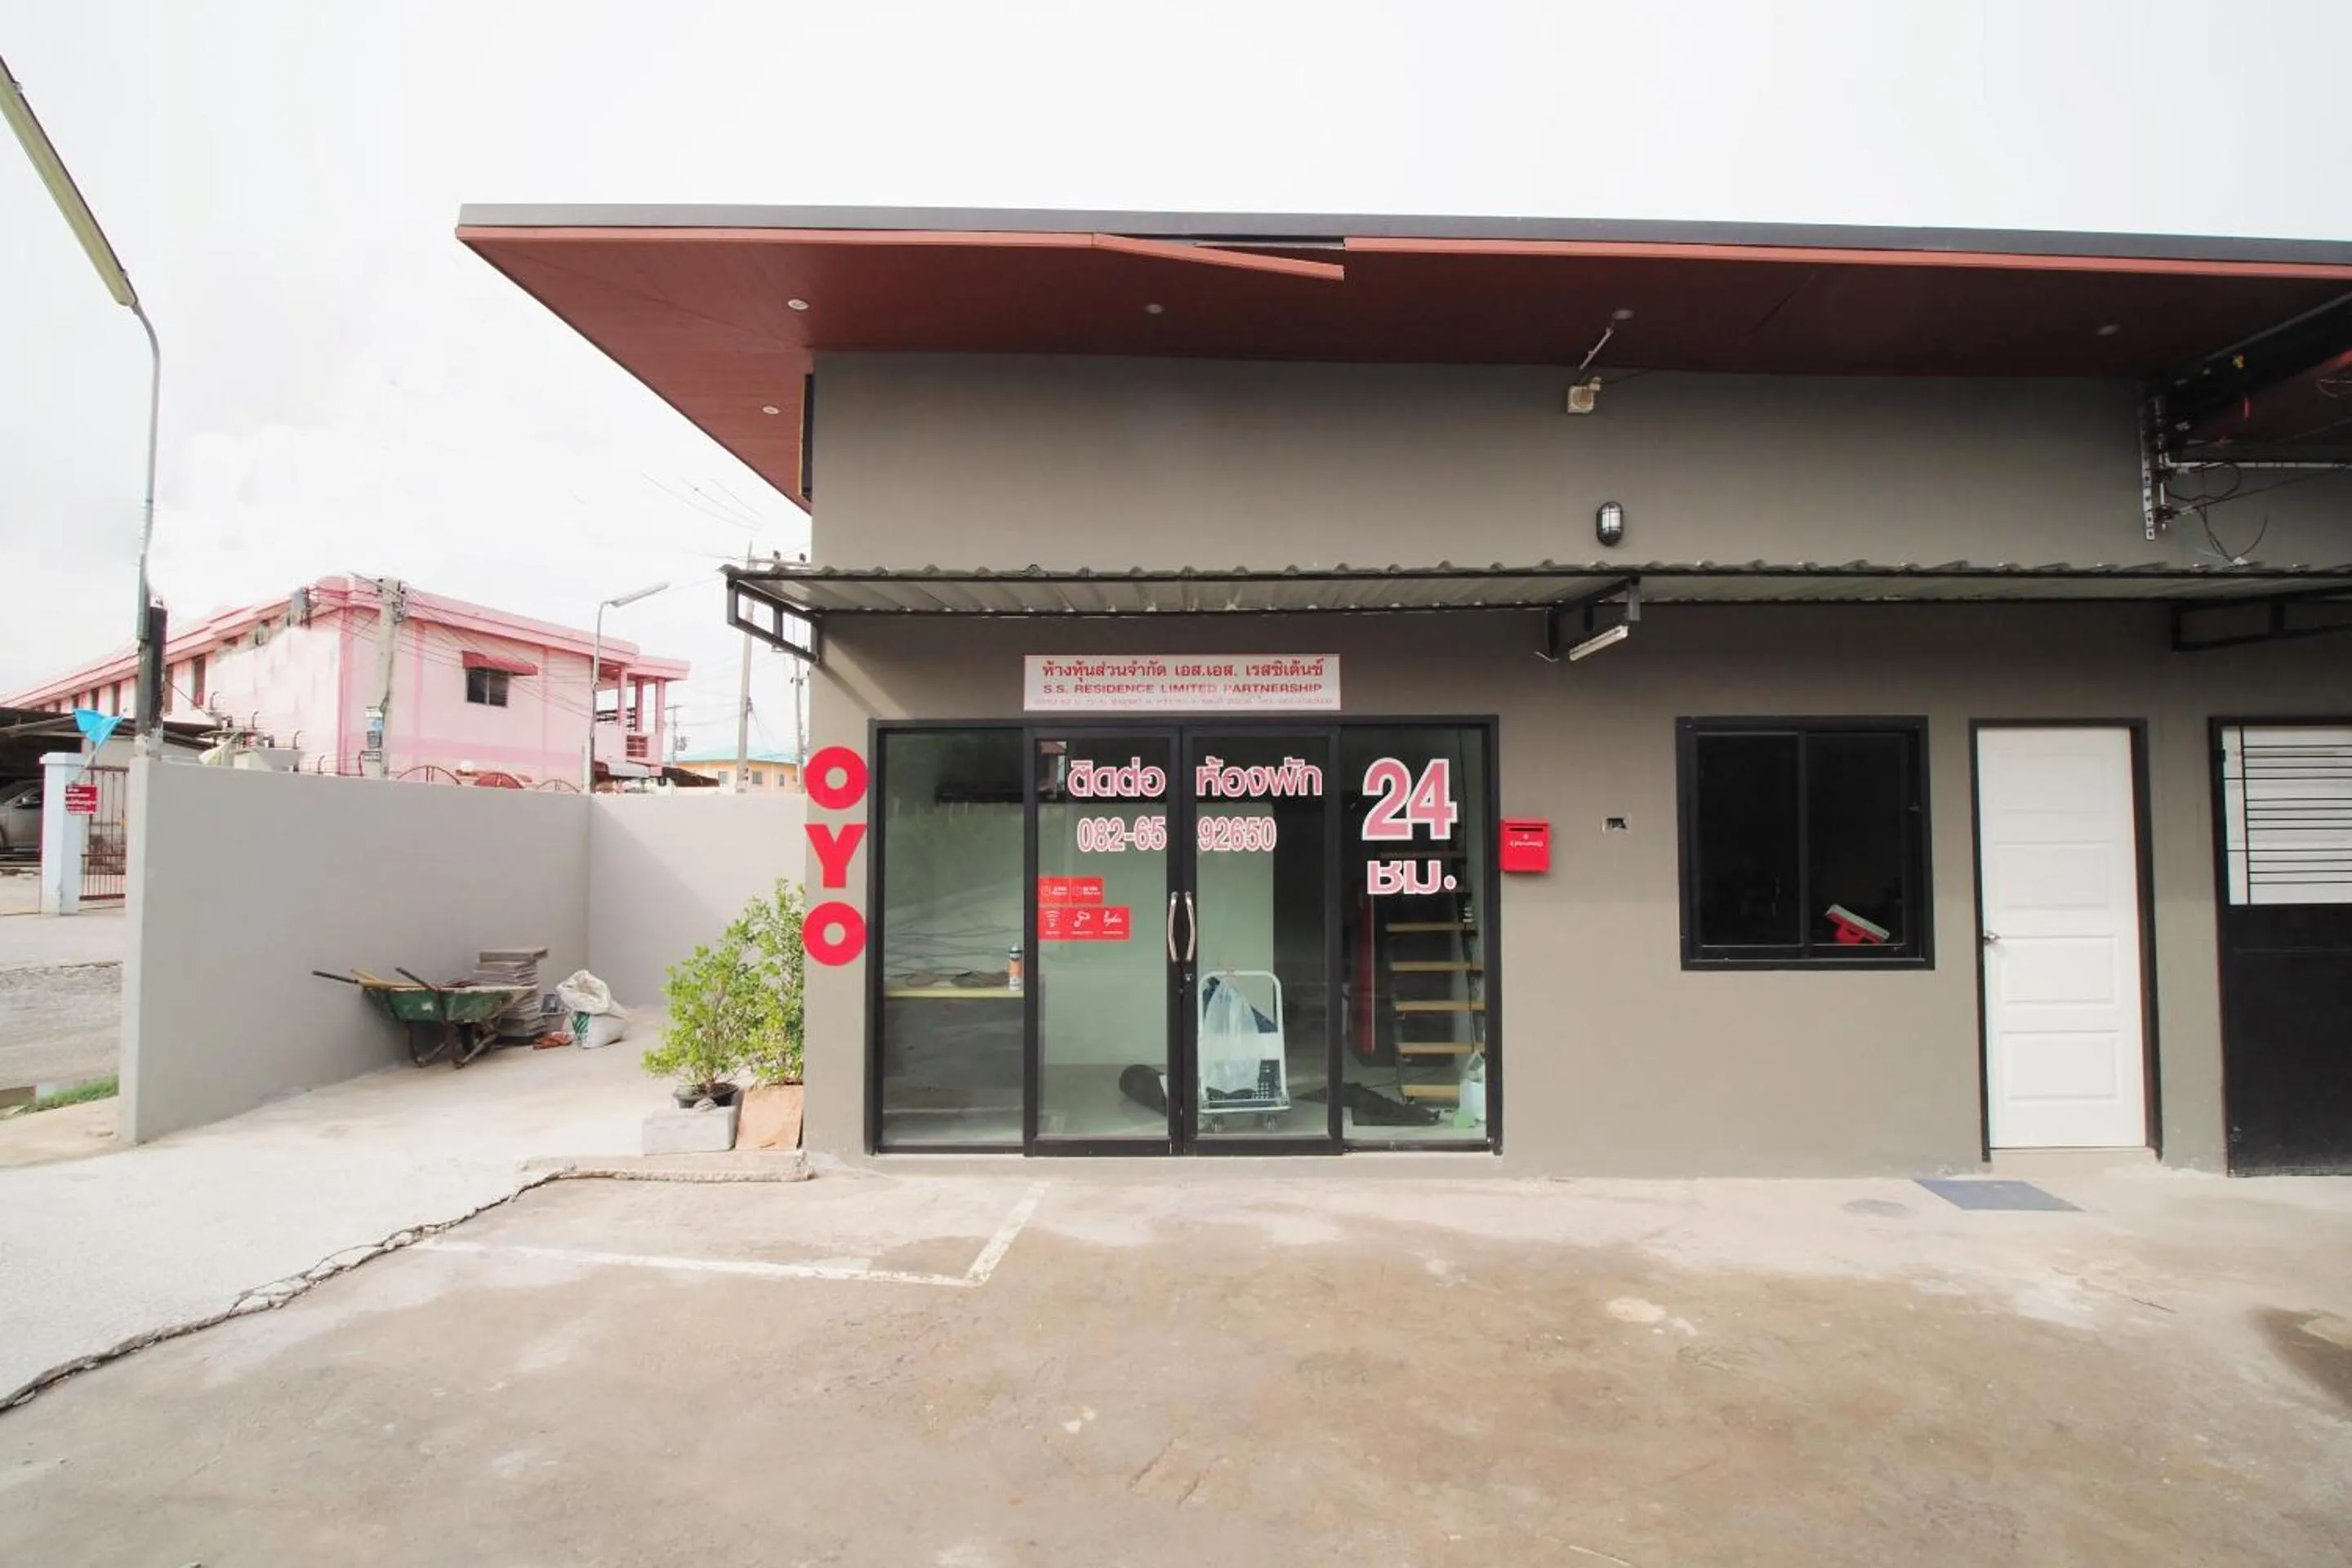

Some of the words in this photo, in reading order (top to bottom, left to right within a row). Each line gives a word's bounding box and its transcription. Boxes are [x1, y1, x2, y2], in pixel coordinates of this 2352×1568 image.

[1042, 660, 1167, 682] ห้างหุ้นส่วนจำกัด
[1074, 684, 1155, 694] RESIDENCE
[1161, 684, 1217, 694] LIMITED
[1223, 683, 1323, 693] PARTNERSHIP
[1067, 756, 1167, 798] ติดต่อ
[1195, 755, 1323, 797] ห้องพัก
[1361, 756, 1458, 841] 24
[1076, 816, 1168, 853] 082-65
[1197, 816, 1277, 853] 92650
[804, 746, 869, 967] OYO
